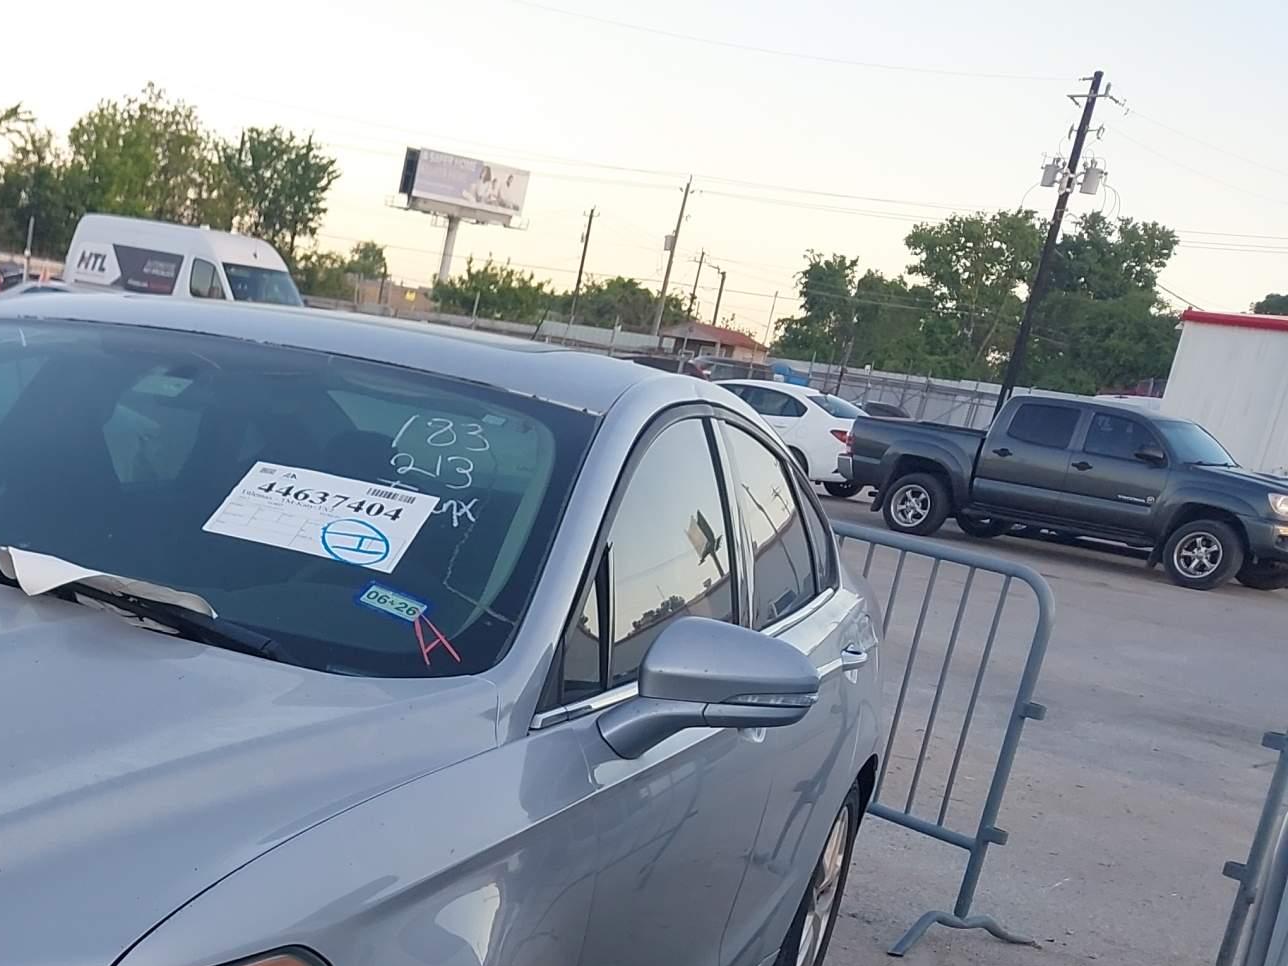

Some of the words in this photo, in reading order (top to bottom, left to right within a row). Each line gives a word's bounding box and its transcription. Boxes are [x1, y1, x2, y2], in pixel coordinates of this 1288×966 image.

[392, 414, 490, 451] 183
[390, 452, 474, 489] 213
[257, 481, 405, 522] 44637404
[414, 612, 461, 666] A
